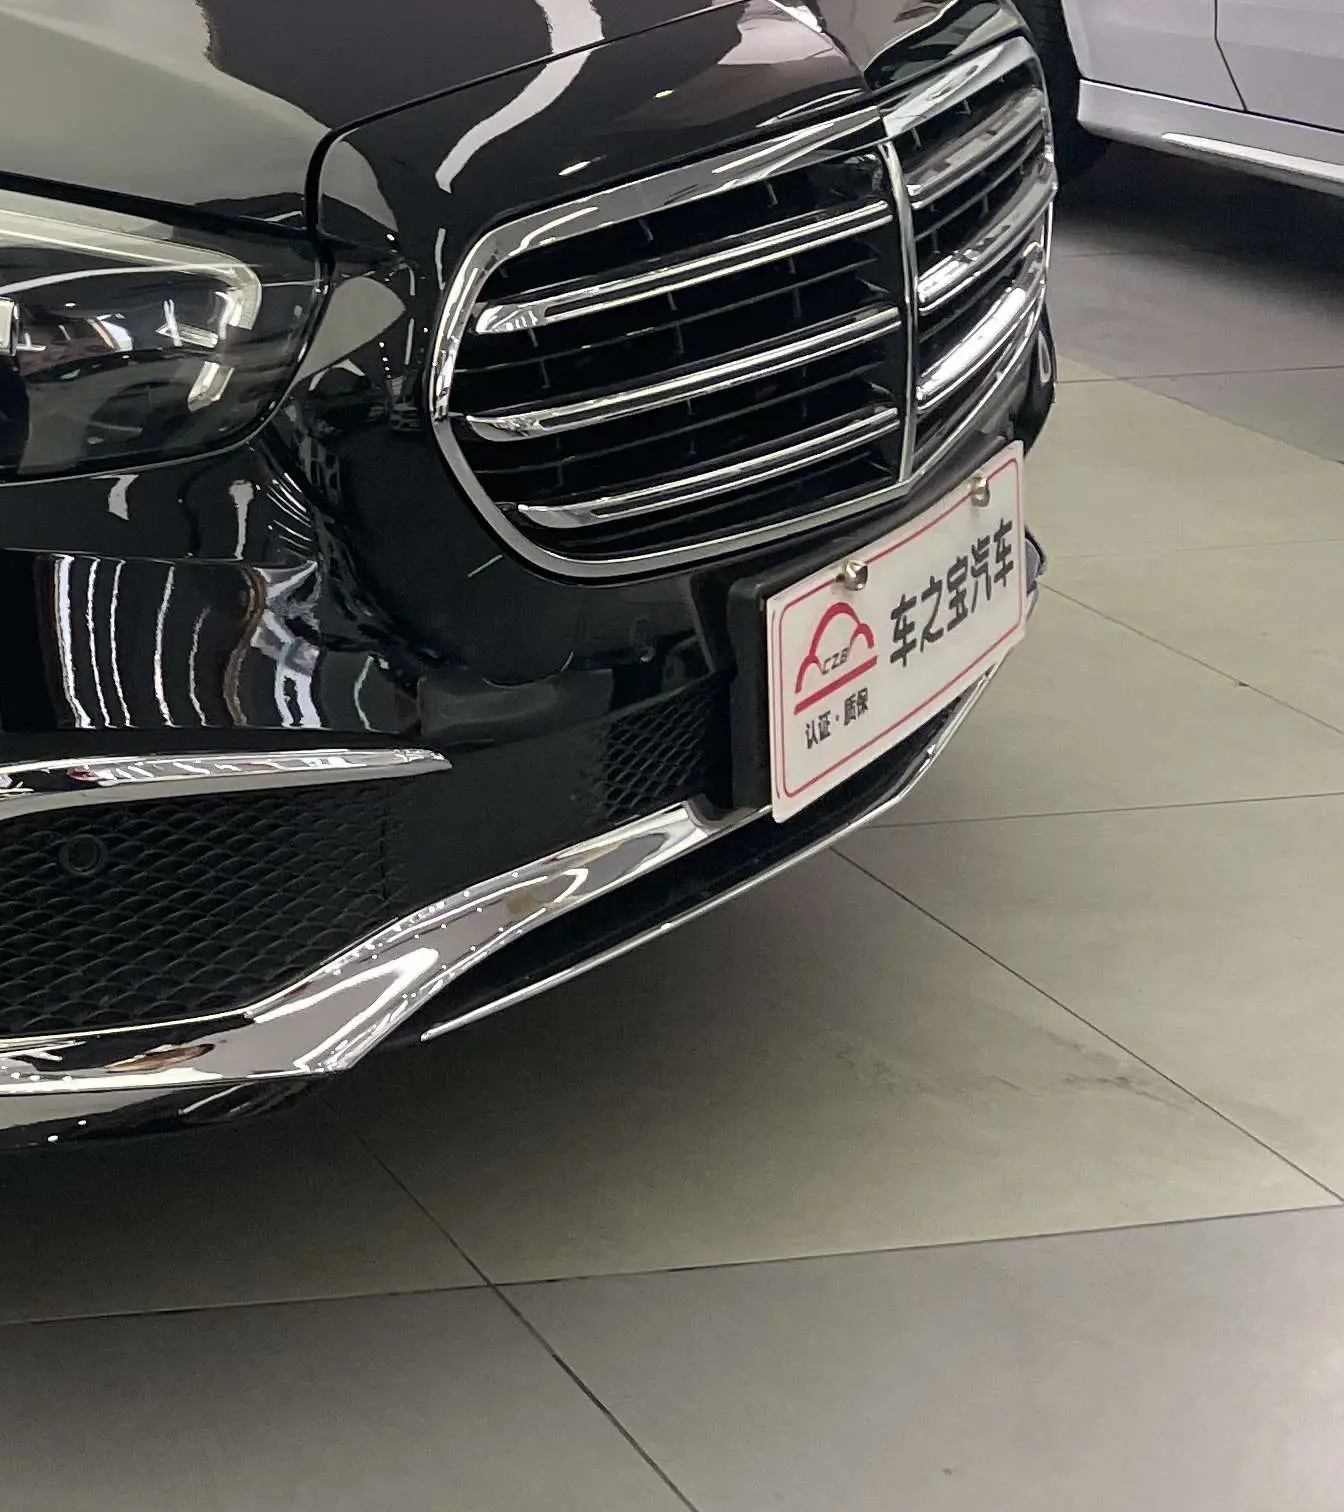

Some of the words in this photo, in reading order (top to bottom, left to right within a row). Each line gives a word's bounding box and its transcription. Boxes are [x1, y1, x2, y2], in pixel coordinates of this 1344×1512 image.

[889, 518, 1014, 668] 车之宝汽车
[821, 645, 850, 676] CZB
